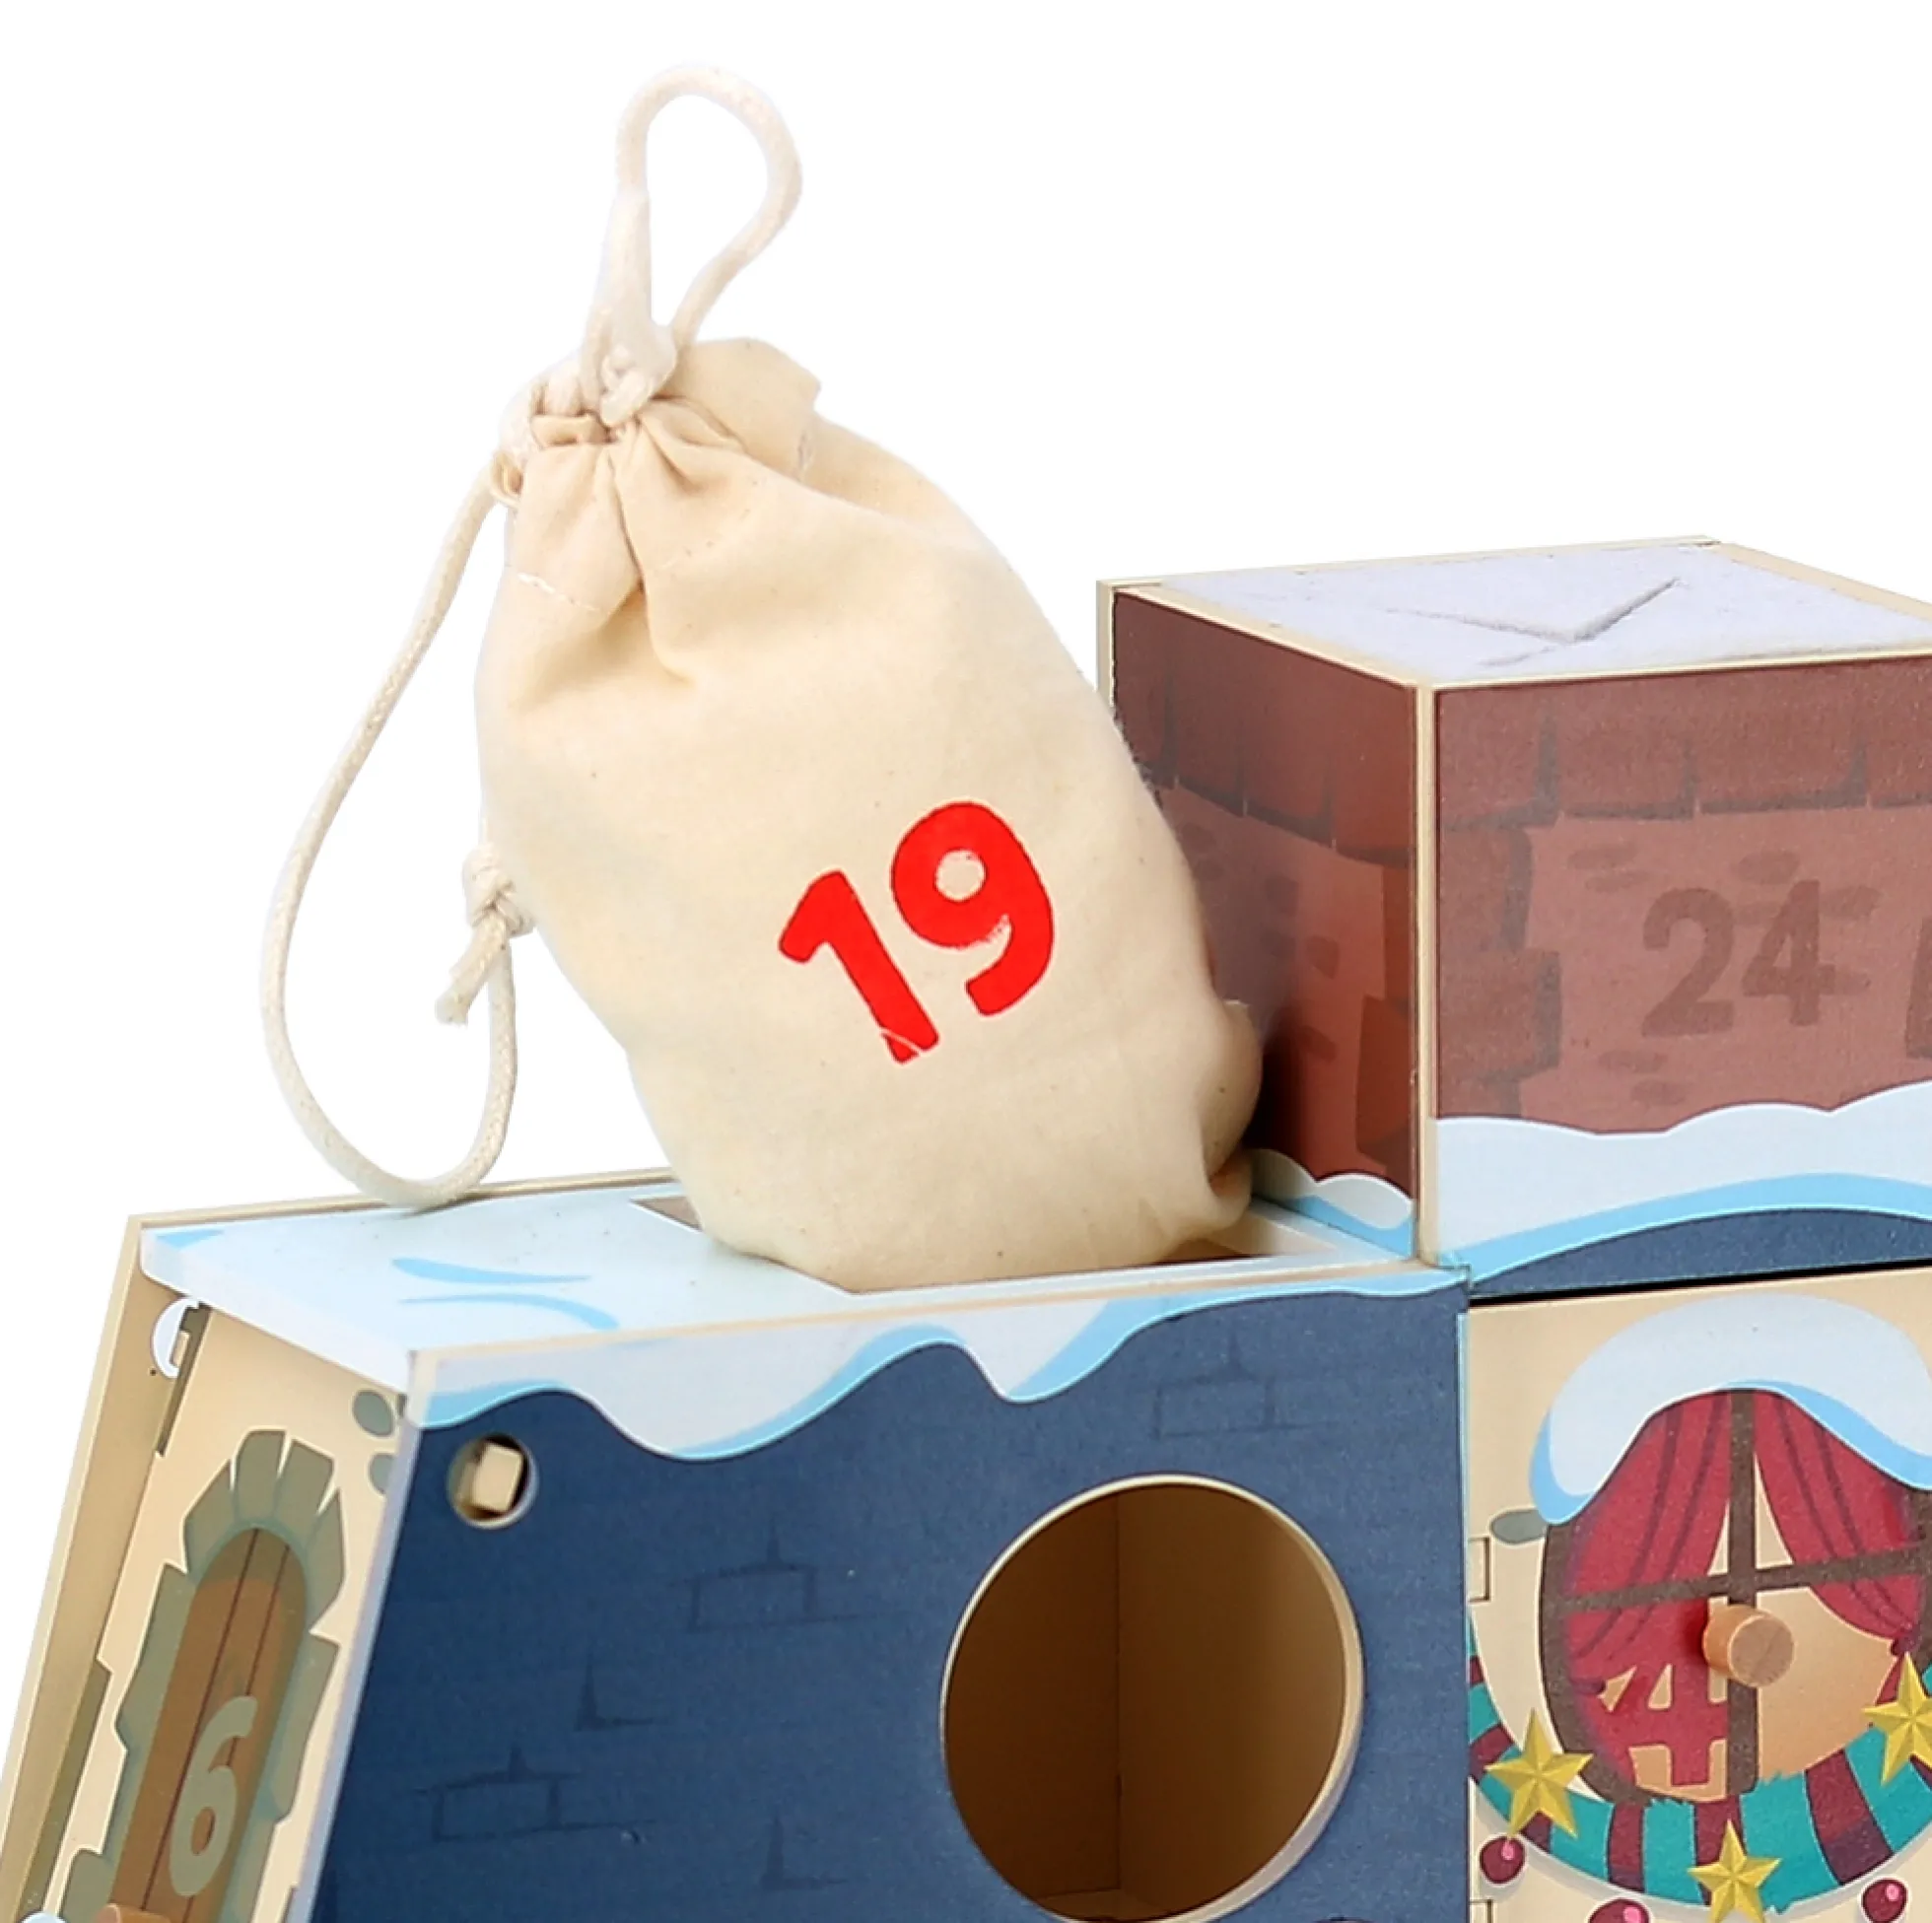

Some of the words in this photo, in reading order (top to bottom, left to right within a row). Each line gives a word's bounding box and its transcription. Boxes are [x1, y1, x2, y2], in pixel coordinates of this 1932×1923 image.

[779, 801, 1055, 1064] 19
[1642, 880, 1834, 1036] 24
[1607, 1618, 1729, 1787] 4
[170, 1695, 257, 1896] 6
